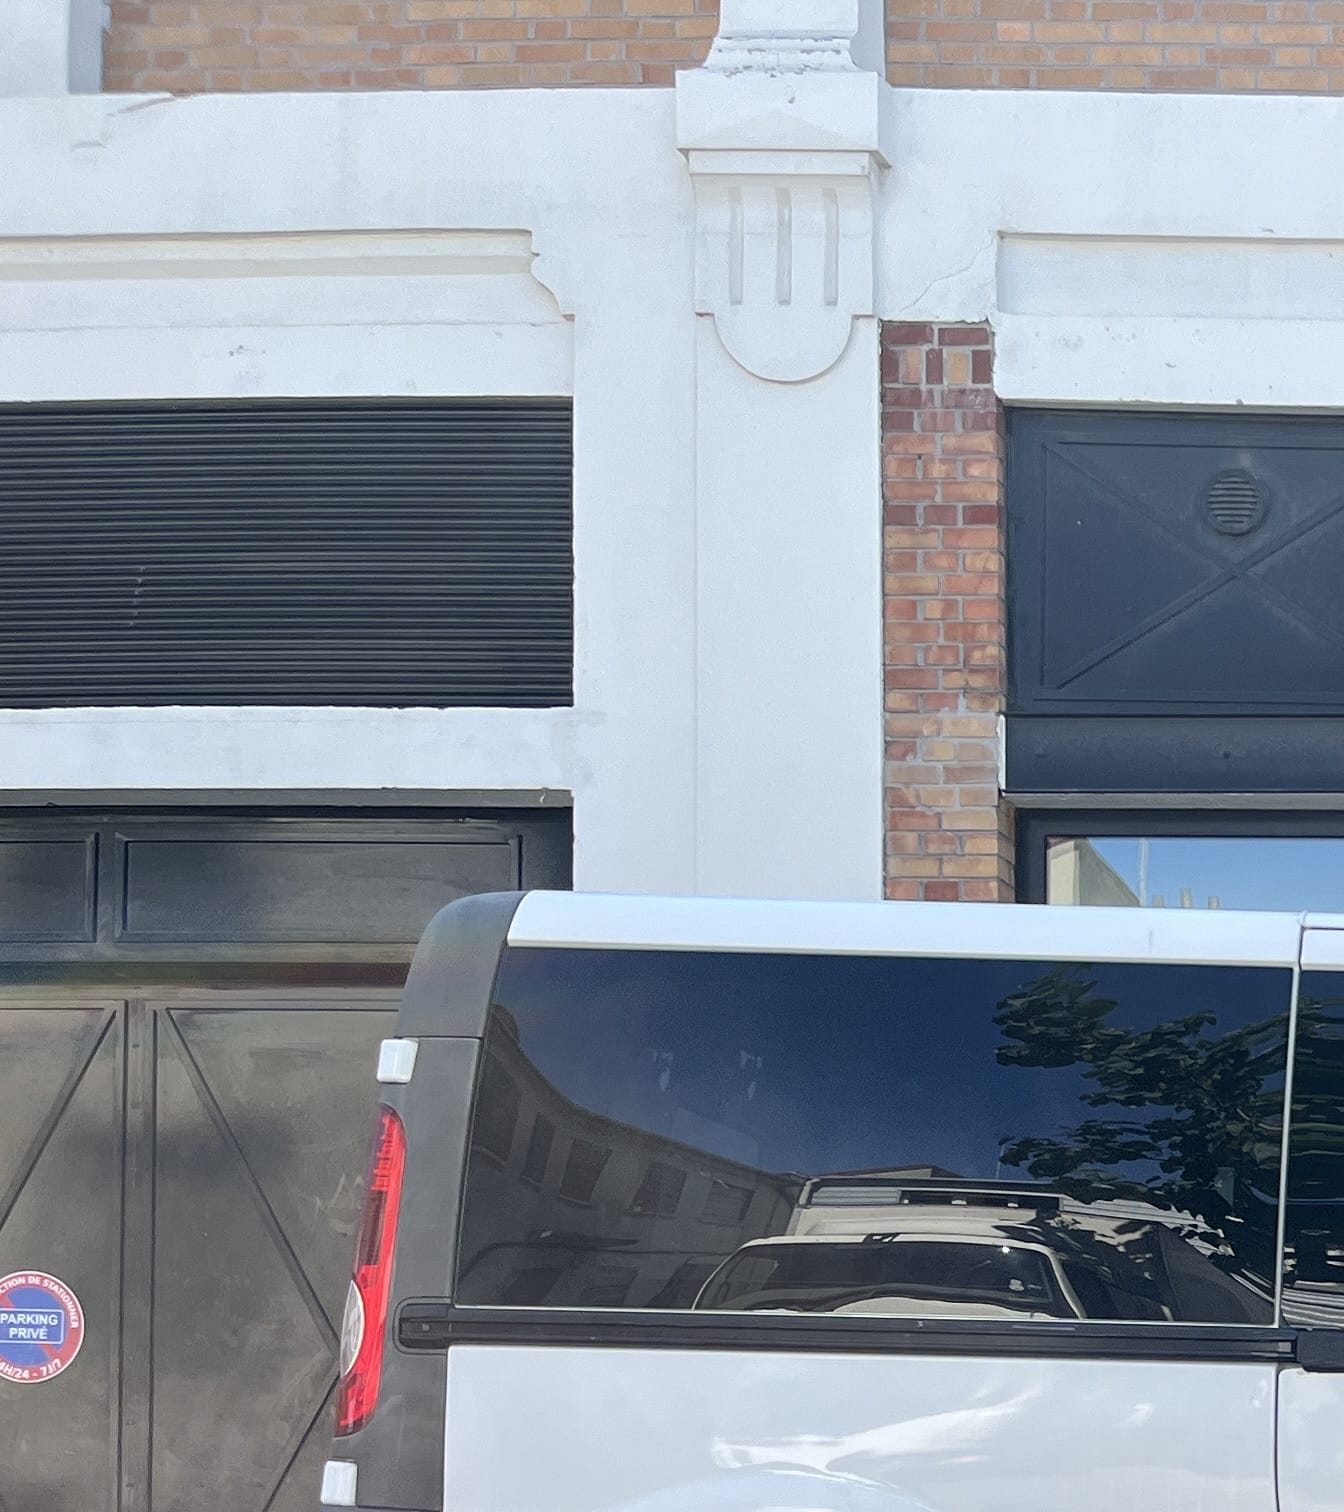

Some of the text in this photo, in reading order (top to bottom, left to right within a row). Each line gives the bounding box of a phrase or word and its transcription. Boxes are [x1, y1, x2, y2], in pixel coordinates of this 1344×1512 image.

[27, 1275, 42, 1285] DE
[0, 1313, 59, 1326] PARKING
[9, 1326, 49, 1340] PRIVÉ
